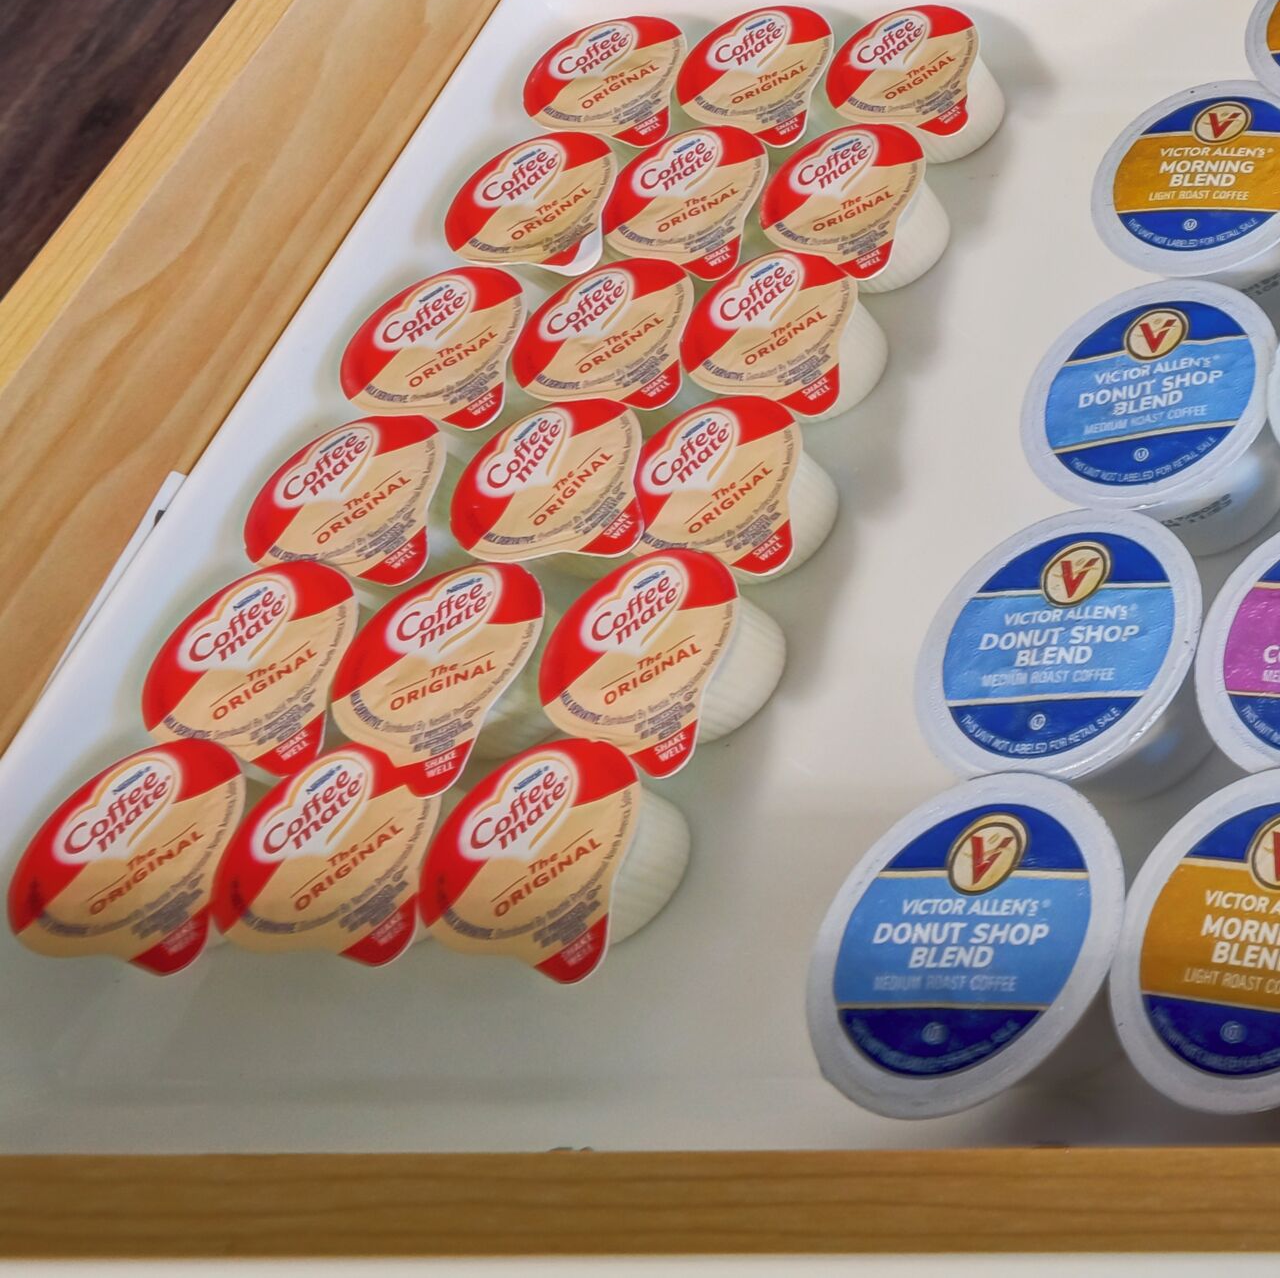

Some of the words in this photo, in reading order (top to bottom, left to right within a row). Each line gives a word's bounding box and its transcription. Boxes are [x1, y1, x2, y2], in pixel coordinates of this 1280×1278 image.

[558, 28, 620, 74] Coffee
[580, 32, 626, 74] mate
[715, 20, 776, 63] Coffee
[736, 28, 781, 66] mate
[857, 20, 914, 63] Coffee
[880, 26, 921, 64] mate
[581, 64, 659, 110] ORIGINAL
[482, 149, 548, 201] Coffee
[640, 142, 706, 190] Coffee
[662, 150, 712, 191] mate
[798, 141, 862, 186] Coffee
[820, 148, 868, 189] mate
[1160, 148, 1210, 157] VICTOR
[1160, 161, 1254, 173] MORNING
[506, 158, 556, 200] mate
[1170, 174, 1236, 187] BLEND
[511, 188, 591, 240] ORIGINAL
[813, 190, 894, 231] ORIGINAL
[382, 289, 454, 344] Coffee
[547, 277, 614, 334] Coffee
[573, 286, 624, 332] mate
[720, 266, 786, 322] Coffee
[745, 274, 792, 322] mate
[408, 298, 464, 342] mate
[580, 316, 664, 374] ORIGINAL
[1078, 383, 1156, 408] DONUT
[1162, 371, 1223, 390] SHOP
[1112, 391, 1182, 416] BLEND
[283, 433, 357, 500] Coffee
[310, 443, 366, 496] mate
[488, 420, 550, 489] Coffee
[516, 423, 560, 482] mate
[651, 422, 720, 485] Coffee
[677, 428, 729, 483] mate
[317, 478, 411, 544] ORIGINAL
[688, 470, 772, 534] ORIGINAL
[190, 590, 274, 662] Coffee
[218, 602, 281, 660] mate
[397, 582, 485, 642] Coffee
[419, 594, 488, 648] mate
[592, 576, 671, 642] Coffee
[616, 586, 678, 645] mate
[1005, 612, 1062, 626] VICTOR
[979, 628, 1066, 651] DONUT
[1070, 625, 1140, 643] SHOP
[1015, 646, 1092, 667] BLEND
[212, 649, 318, 720] ORIGINAL
[391, 660, 496, 711] ORIGINAL
[604, 643, 701, 705] ORIGINAL
[64, 772, 158, 854] Coffee
[98, 780, 166, 852] mate
[263, 770, 348, 854] Coffee
[292, 780, 360, 850] mate
[470, 771, 556, 849] Coffee
[498, 782, 566, 850] mate
[903, 898, 966, 915] VICTOR
[1204, 890, 1267, 913] VICTOR
[873, 922, 964, 944] DONUT
[970, 923, 1049, 945] SHOP
[909, 946, 994, 969] BLEND
